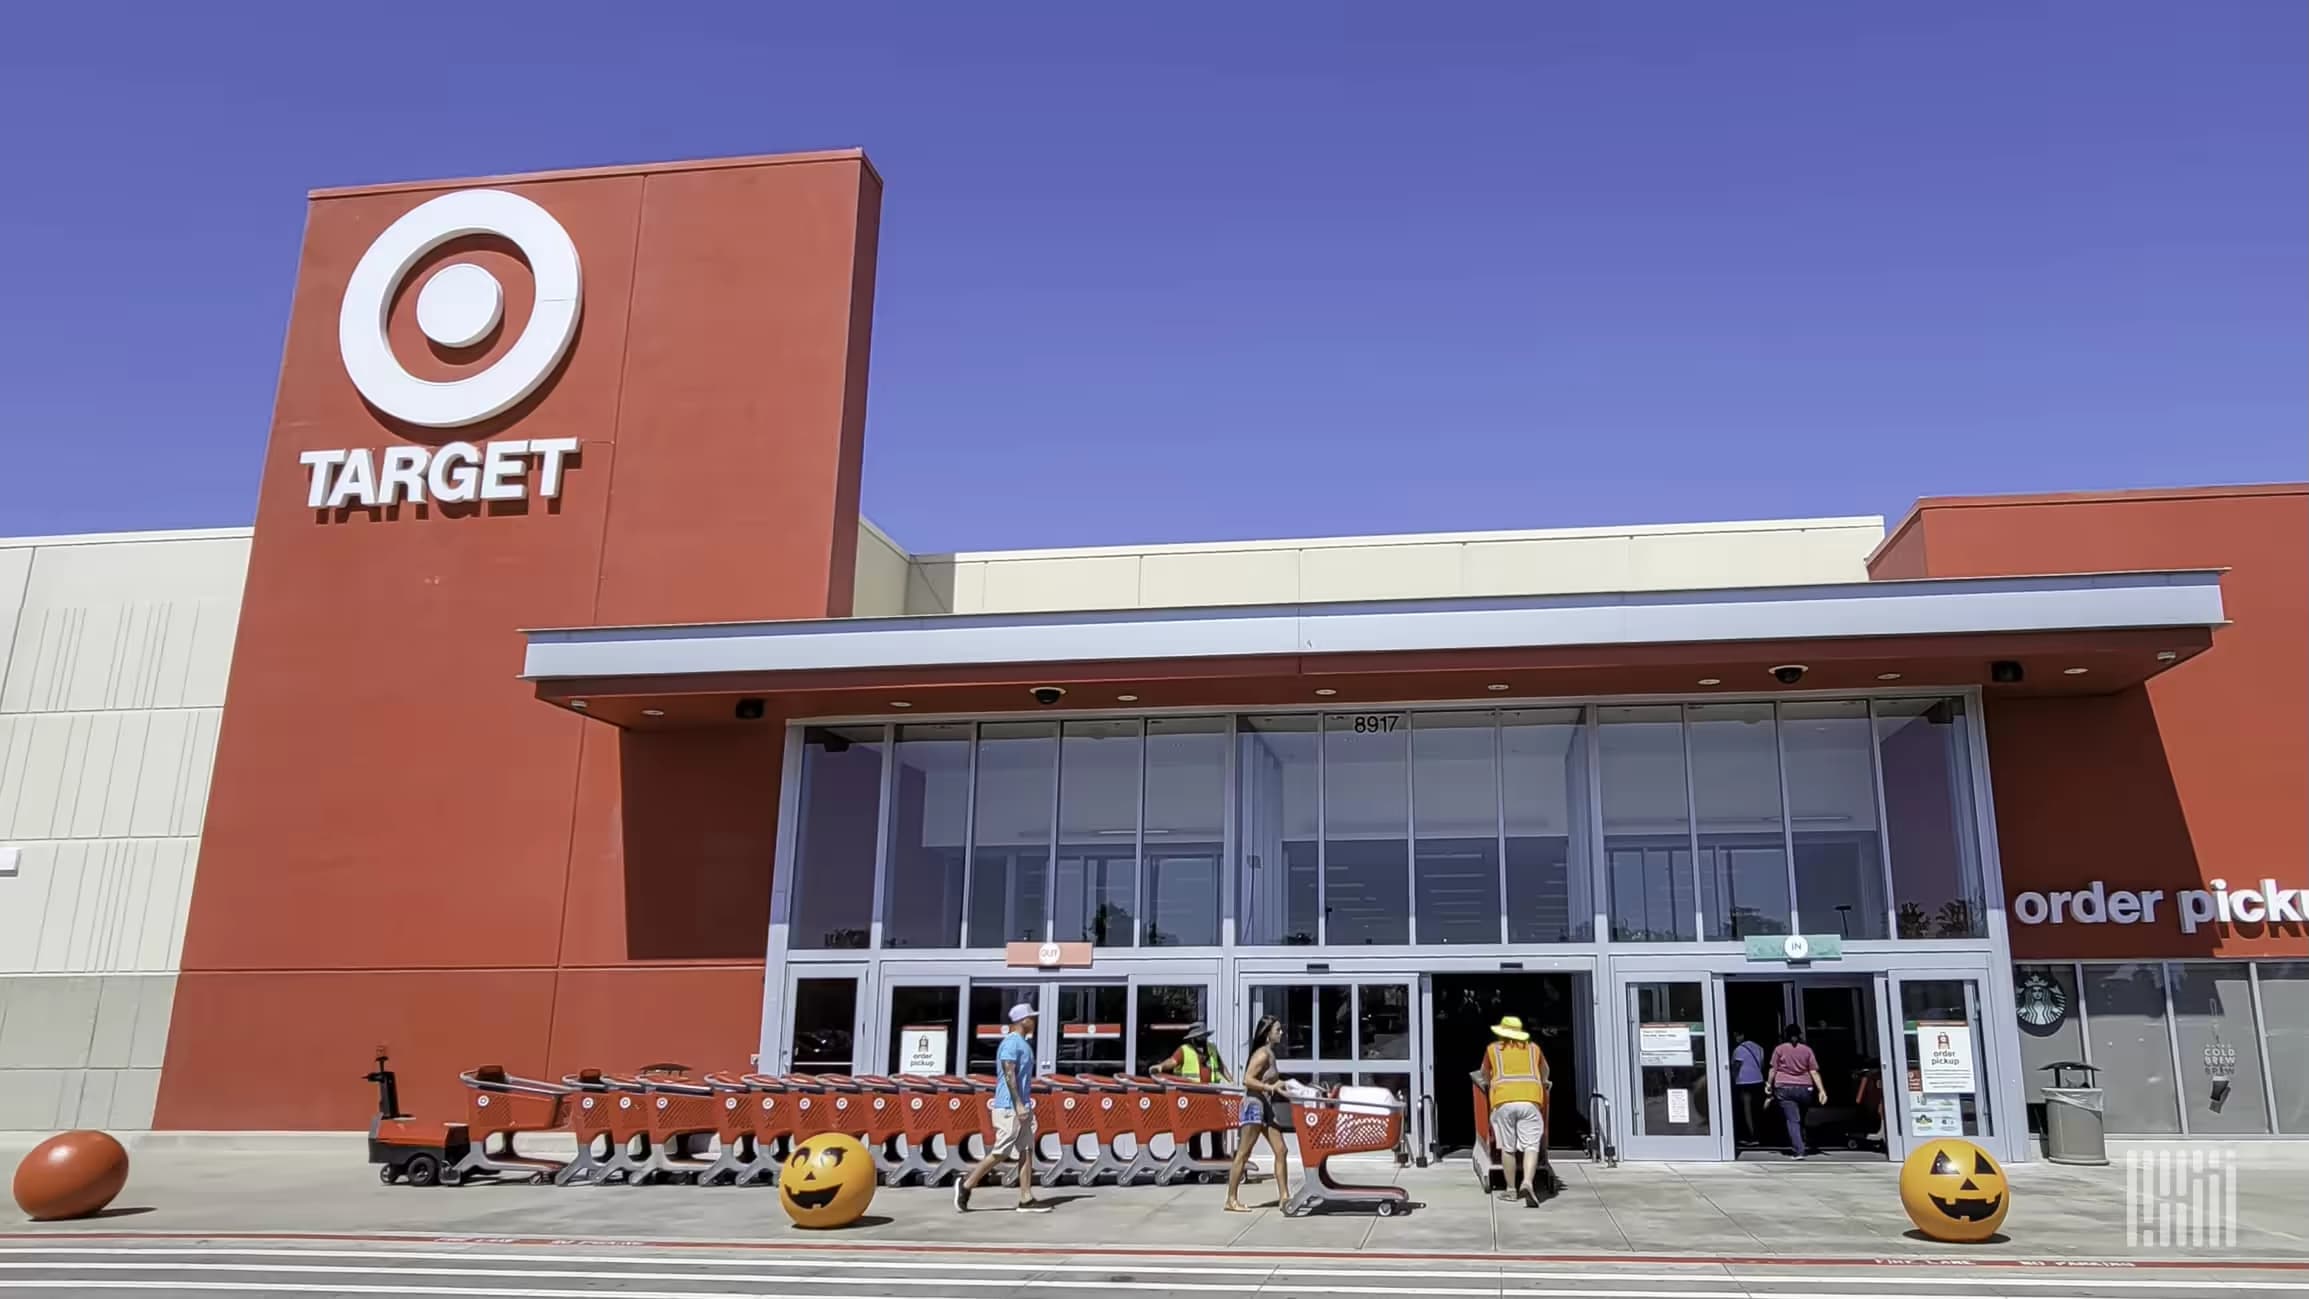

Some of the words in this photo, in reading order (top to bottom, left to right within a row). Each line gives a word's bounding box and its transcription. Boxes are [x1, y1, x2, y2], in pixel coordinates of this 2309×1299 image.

[299, 436, 578, 507] TARGET
[1355, 716, 1399, 733] 8917
[2014, 880, 2164, 925] order
[1041, 948, 1058, 957] OUT
[2204, 1048, 2235, 1056] COLD
[910, 1060, 935, 1068] pickup
[1931, 1057, 1960, 1065] pickup
[2204, 1056, 2235, 1065] BREW
